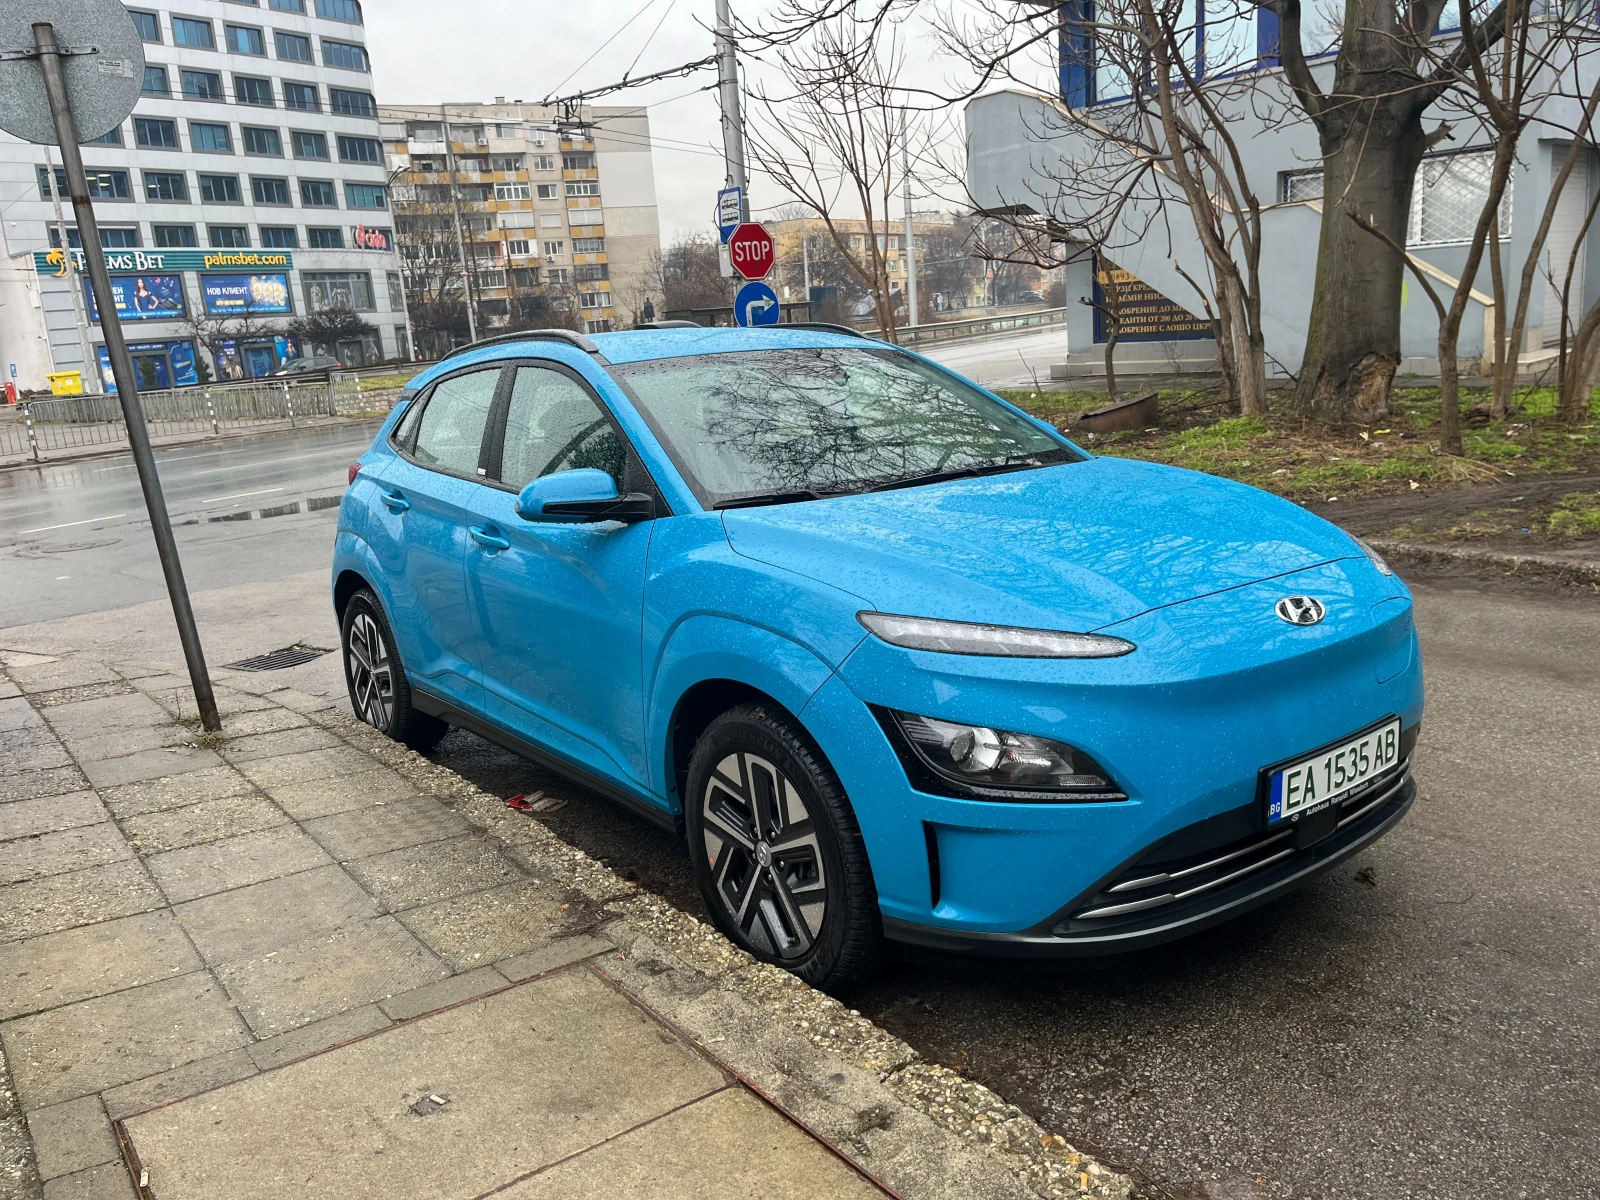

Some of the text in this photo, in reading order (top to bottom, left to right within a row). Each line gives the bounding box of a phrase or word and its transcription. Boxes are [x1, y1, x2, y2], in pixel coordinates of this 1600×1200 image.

[734, 240, 770, 262] STOP
[75, 252, 132, 271] PMS
[204, 251, 287, 269] palmsbet.com
[206, 286, 248, 295] НОВ КЛИЕНТ
[1133, 284, 1154, 292] КРЕ
[1144, 292, 1167, 301] НИС
[1159, 304, 1171, 313] ДО
[1172, 303, 1186, 312] МИ
[1147, 315, 1159, 323] ОТ
[1160, 314, 1171, 322] 200
[1172, 314, 1184, 322] ДО
[1111, 324, 1158, 334] ОБРЕНИЕ
[1166, 323, 1191, 332] ЛОШО
[1286, 729, 1395, 810] EA 1535 AB
[1270, 801, 1281, 816] BG
[1306, 800, 1330, 816] Autohaus
